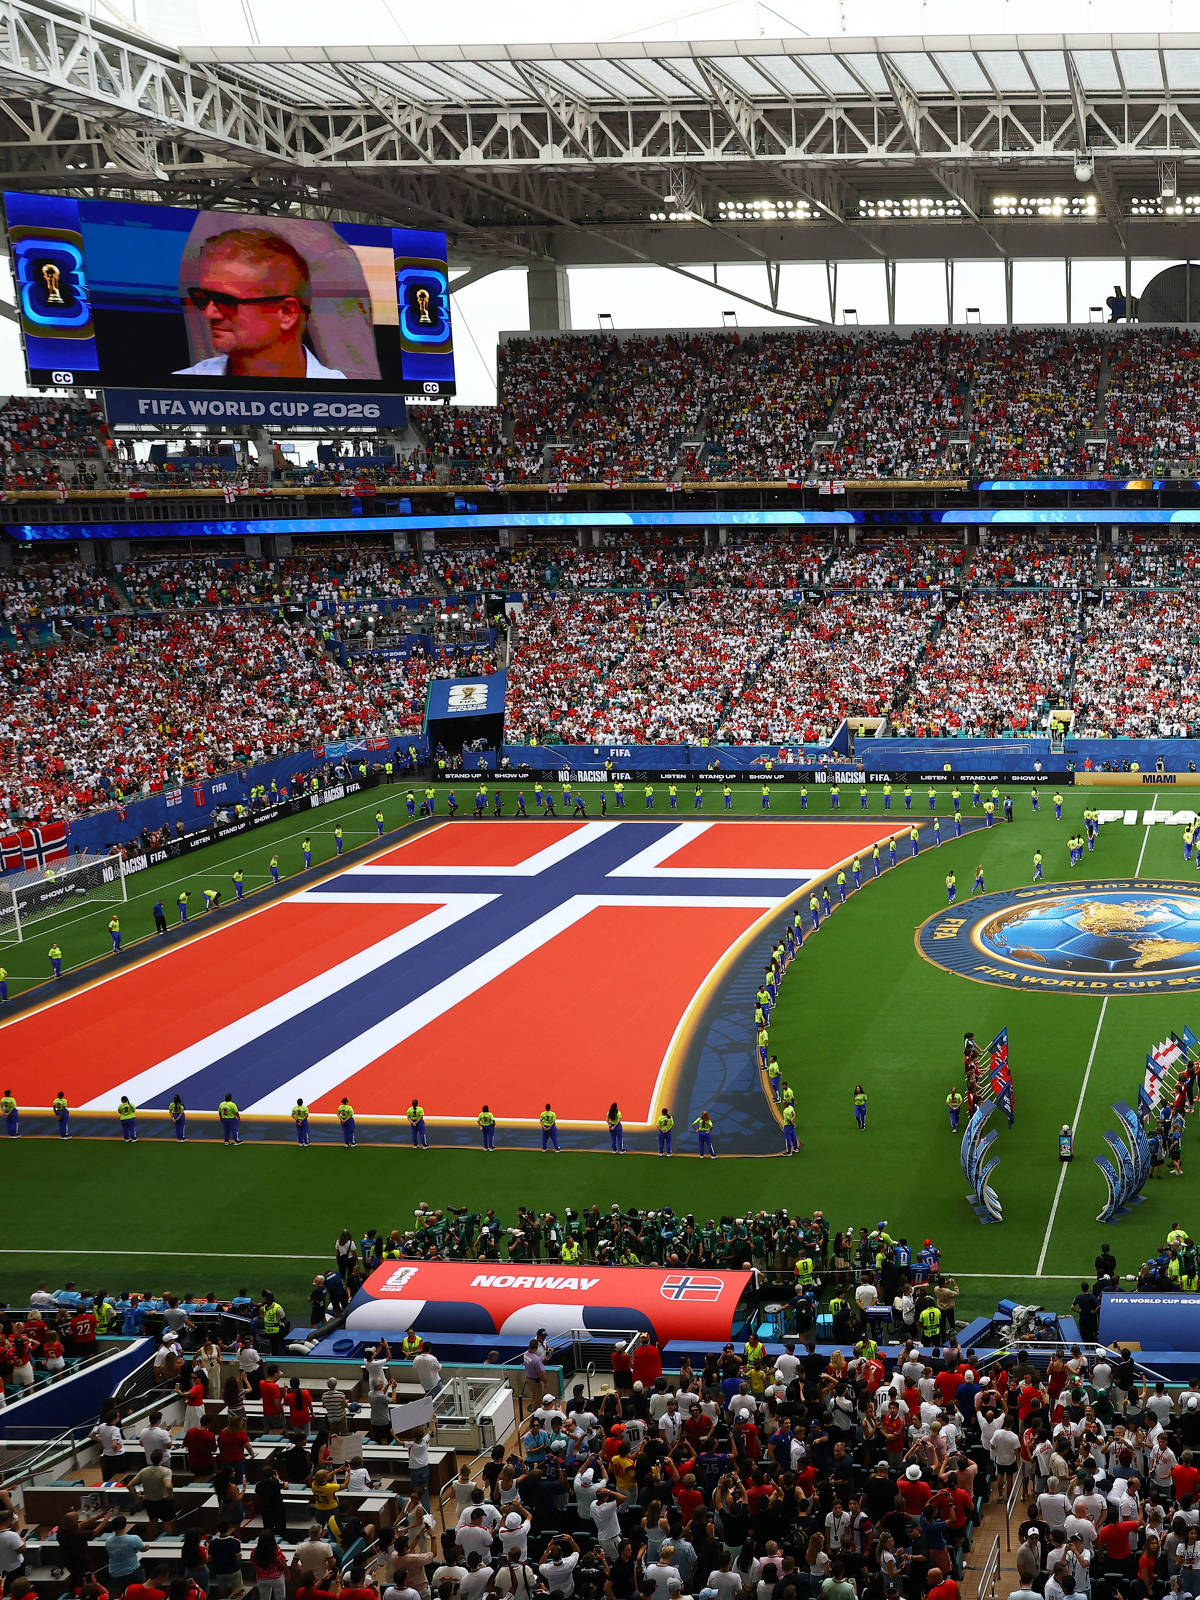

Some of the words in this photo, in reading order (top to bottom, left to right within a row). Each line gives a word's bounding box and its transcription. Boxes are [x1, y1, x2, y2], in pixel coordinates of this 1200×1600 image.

[54, 373, 71, 382] CC
[425, 384, 438, 392] CC
[138, 399, 187, 415] FIFA
[189, 400, 266, 416] WORLD
[269, 401, 310, 417] CUP
[313, 403, 381, 418] 2026
[610, 749, 631, 757] FIFA
[558, 771, 569, 782] NO
[578, 771, 608, 782] RACISM
[814, 772, 827, 784] NO
[834, 772, 866, 784] RACISM
[1142, 774, 1177, 784] MIAMI
[211, 782, 228, 794] FIFA
[310, 793, 319, 807] NO
[323, 786, 345, 803] RACISM
[346, 783, 361, 794] FIFA
[1096, 810, 1199, 825] FIFA
[190, 835, 211, 848] LISTEN
[218, 825, 236, 837] STAND
[236, 823, 246, 832] UP
[254, 814, 270, 825] SHOW
[270, 811, 279, 819] UP
[102, 867, 114, 883] NO
[122, 854, 148, 876] RACISM
[150, 850, 168, 864] FIFA
[40, 888, 64, 901] SHOW
[64, 884, 76, 892] UP
[1015, 884, 1086, 898] 2026
[932, 918, 967, 940] FIFA
[973, 965, 1017, 980] FIFA
[1020, 975, 1108, 988] WORLD
[1113, 980, 1162, 989] CUP
[470, 1275, 600, 1291] NORWAY
[76, 1324, 91, 1336] 22
[876, 1393, 887, 1405] 10
[625, 1429, 640, 1442] 10
